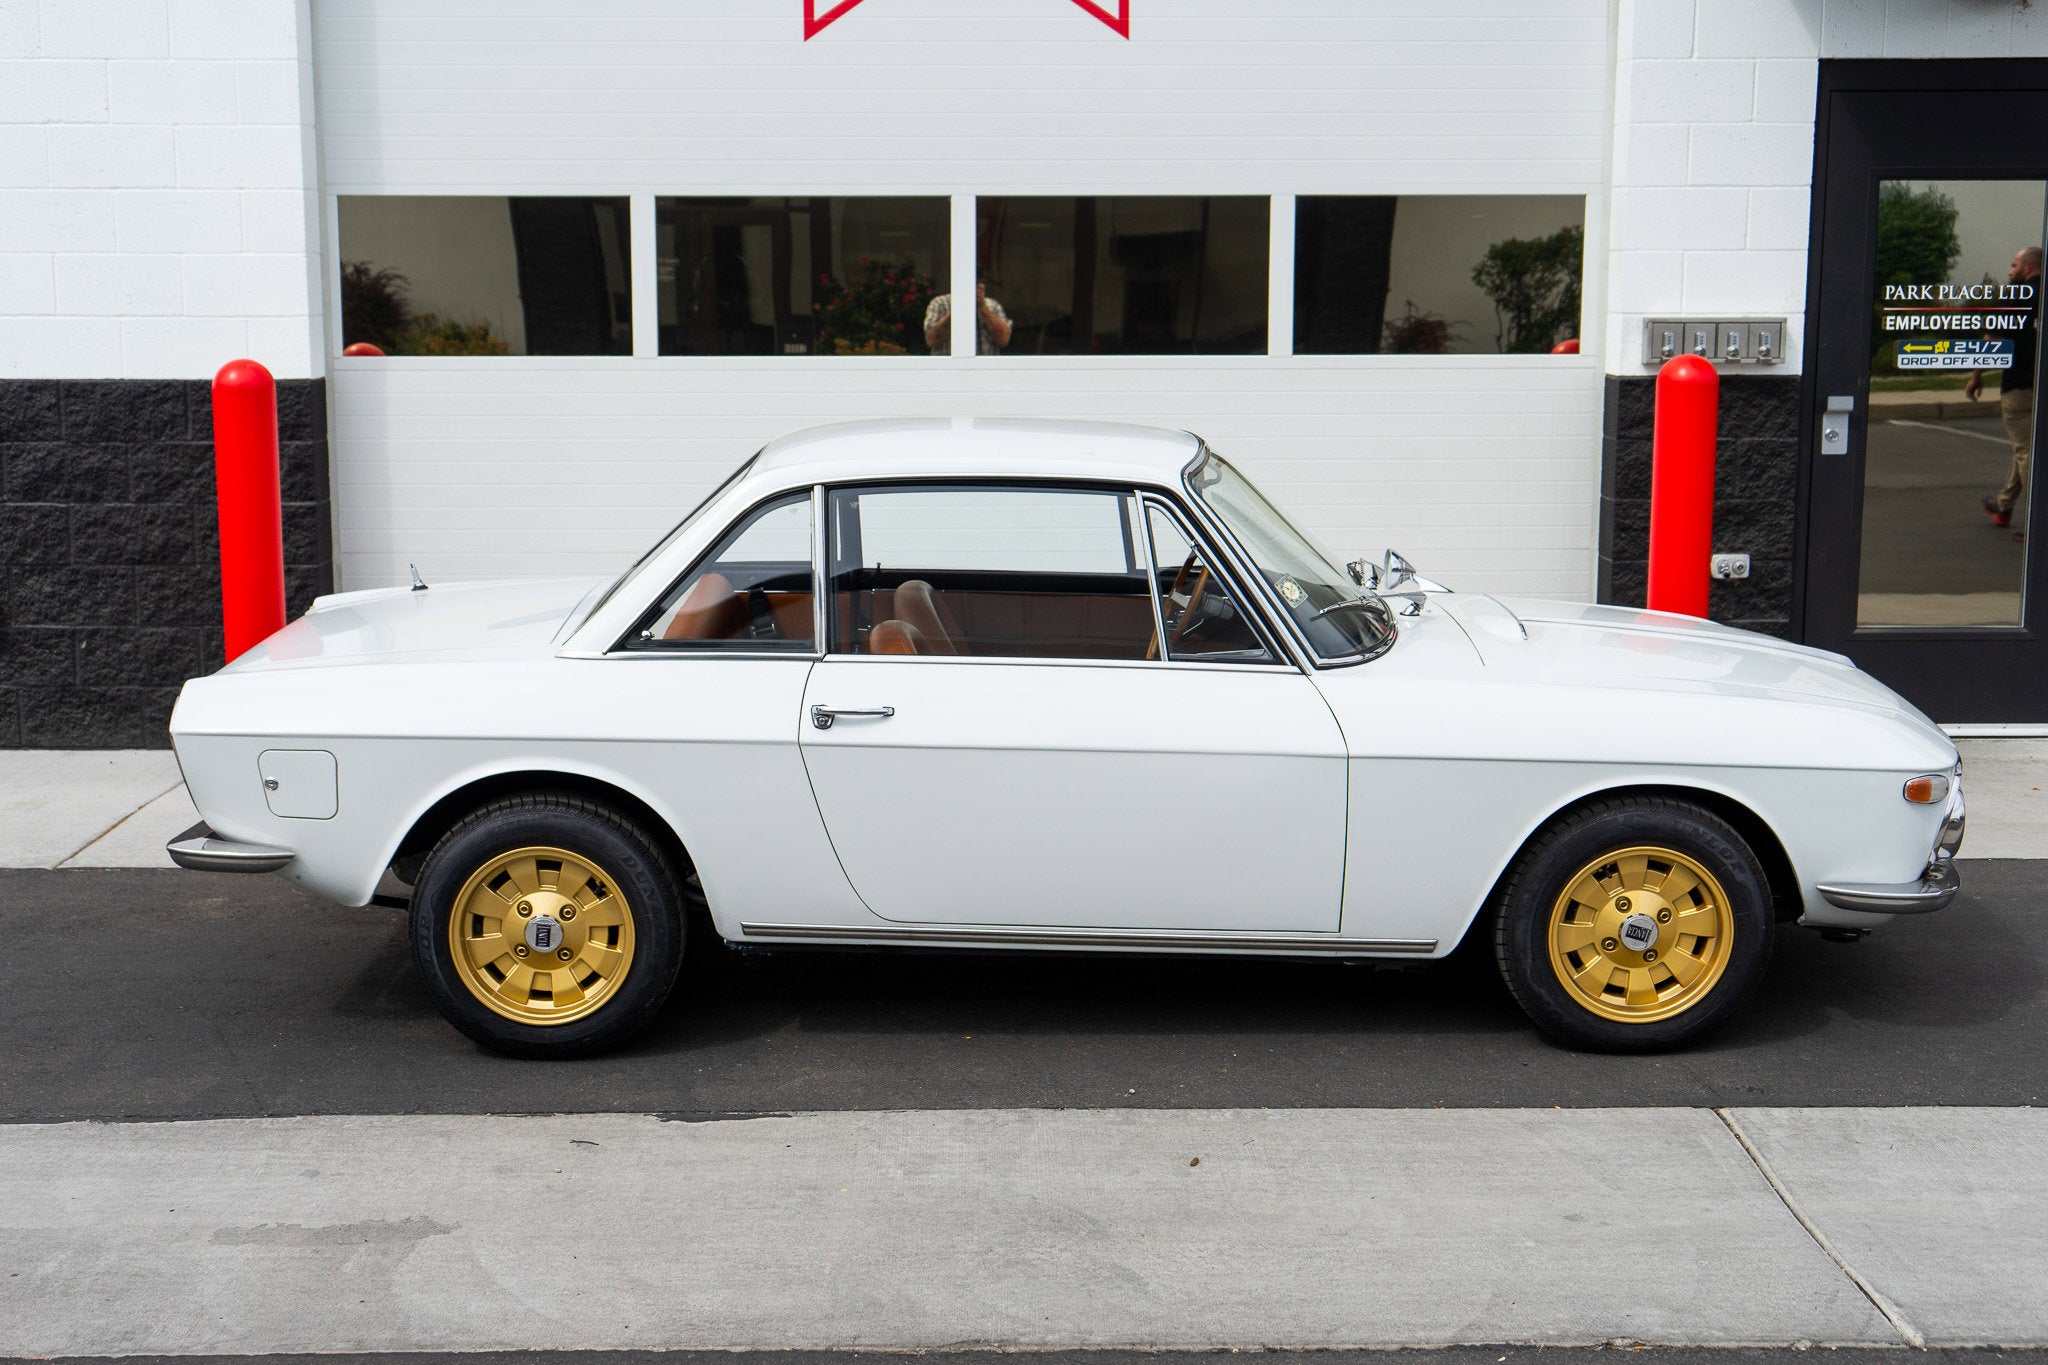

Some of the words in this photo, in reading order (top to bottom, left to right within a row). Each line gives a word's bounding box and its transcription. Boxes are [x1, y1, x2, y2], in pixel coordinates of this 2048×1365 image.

[1885, 285, 1934, 300] PARK
[1939, 285, 1993, 300] PLACE
[1999, 284, 2034, 300] LTD
[1886, 315, 1982, 331] EMPLOYEES
[1986, 315, 2028, 330] ONLY
[1954, 341, 2003, 353] 24/7
[1901, 357, 1939, 366] DROP
[1943, 357, 1970, 366] OFF
[1973, 356, 2010, 366] KEYS
